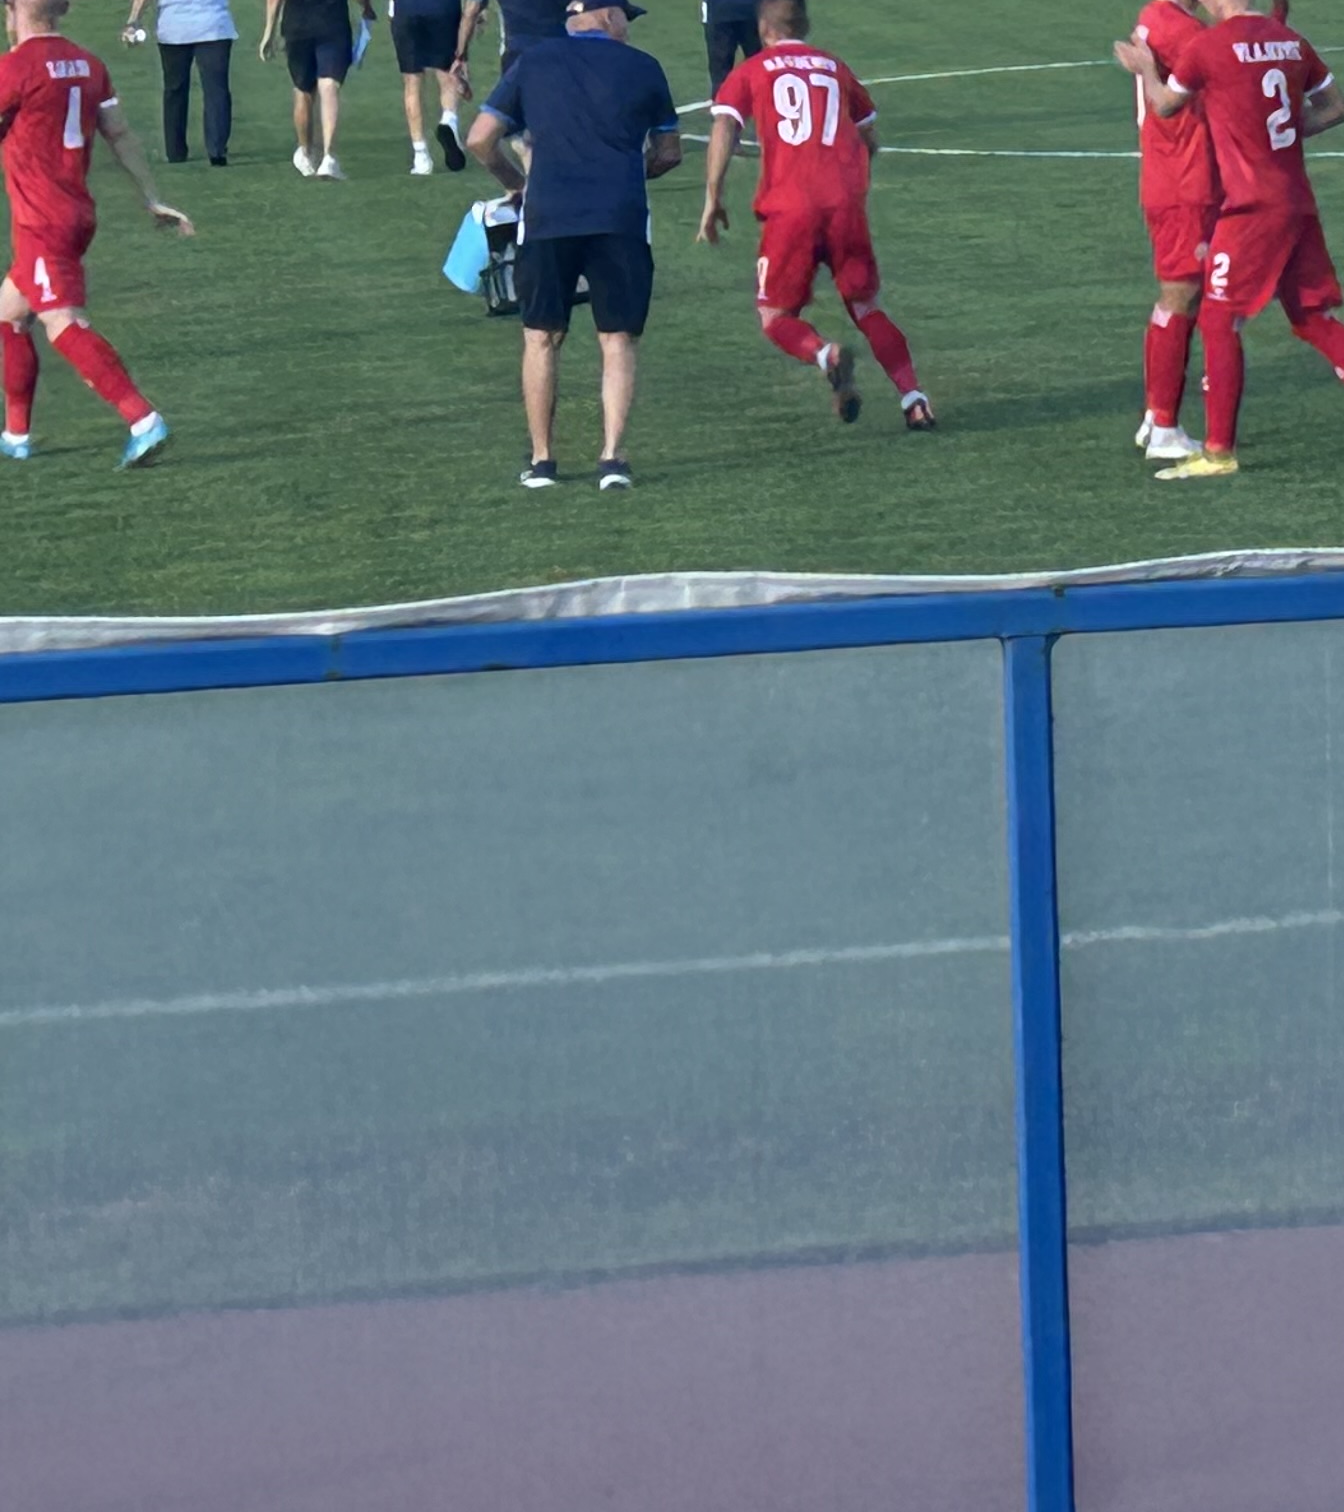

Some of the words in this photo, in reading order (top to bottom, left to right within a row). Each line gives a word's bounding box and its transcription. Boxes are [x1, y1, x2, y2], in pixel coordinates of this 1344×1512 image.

[772, 72, 841, 147] 97
[1262, 68, 1297, 151] 2
[1210, 252, 1231, 287] 2
